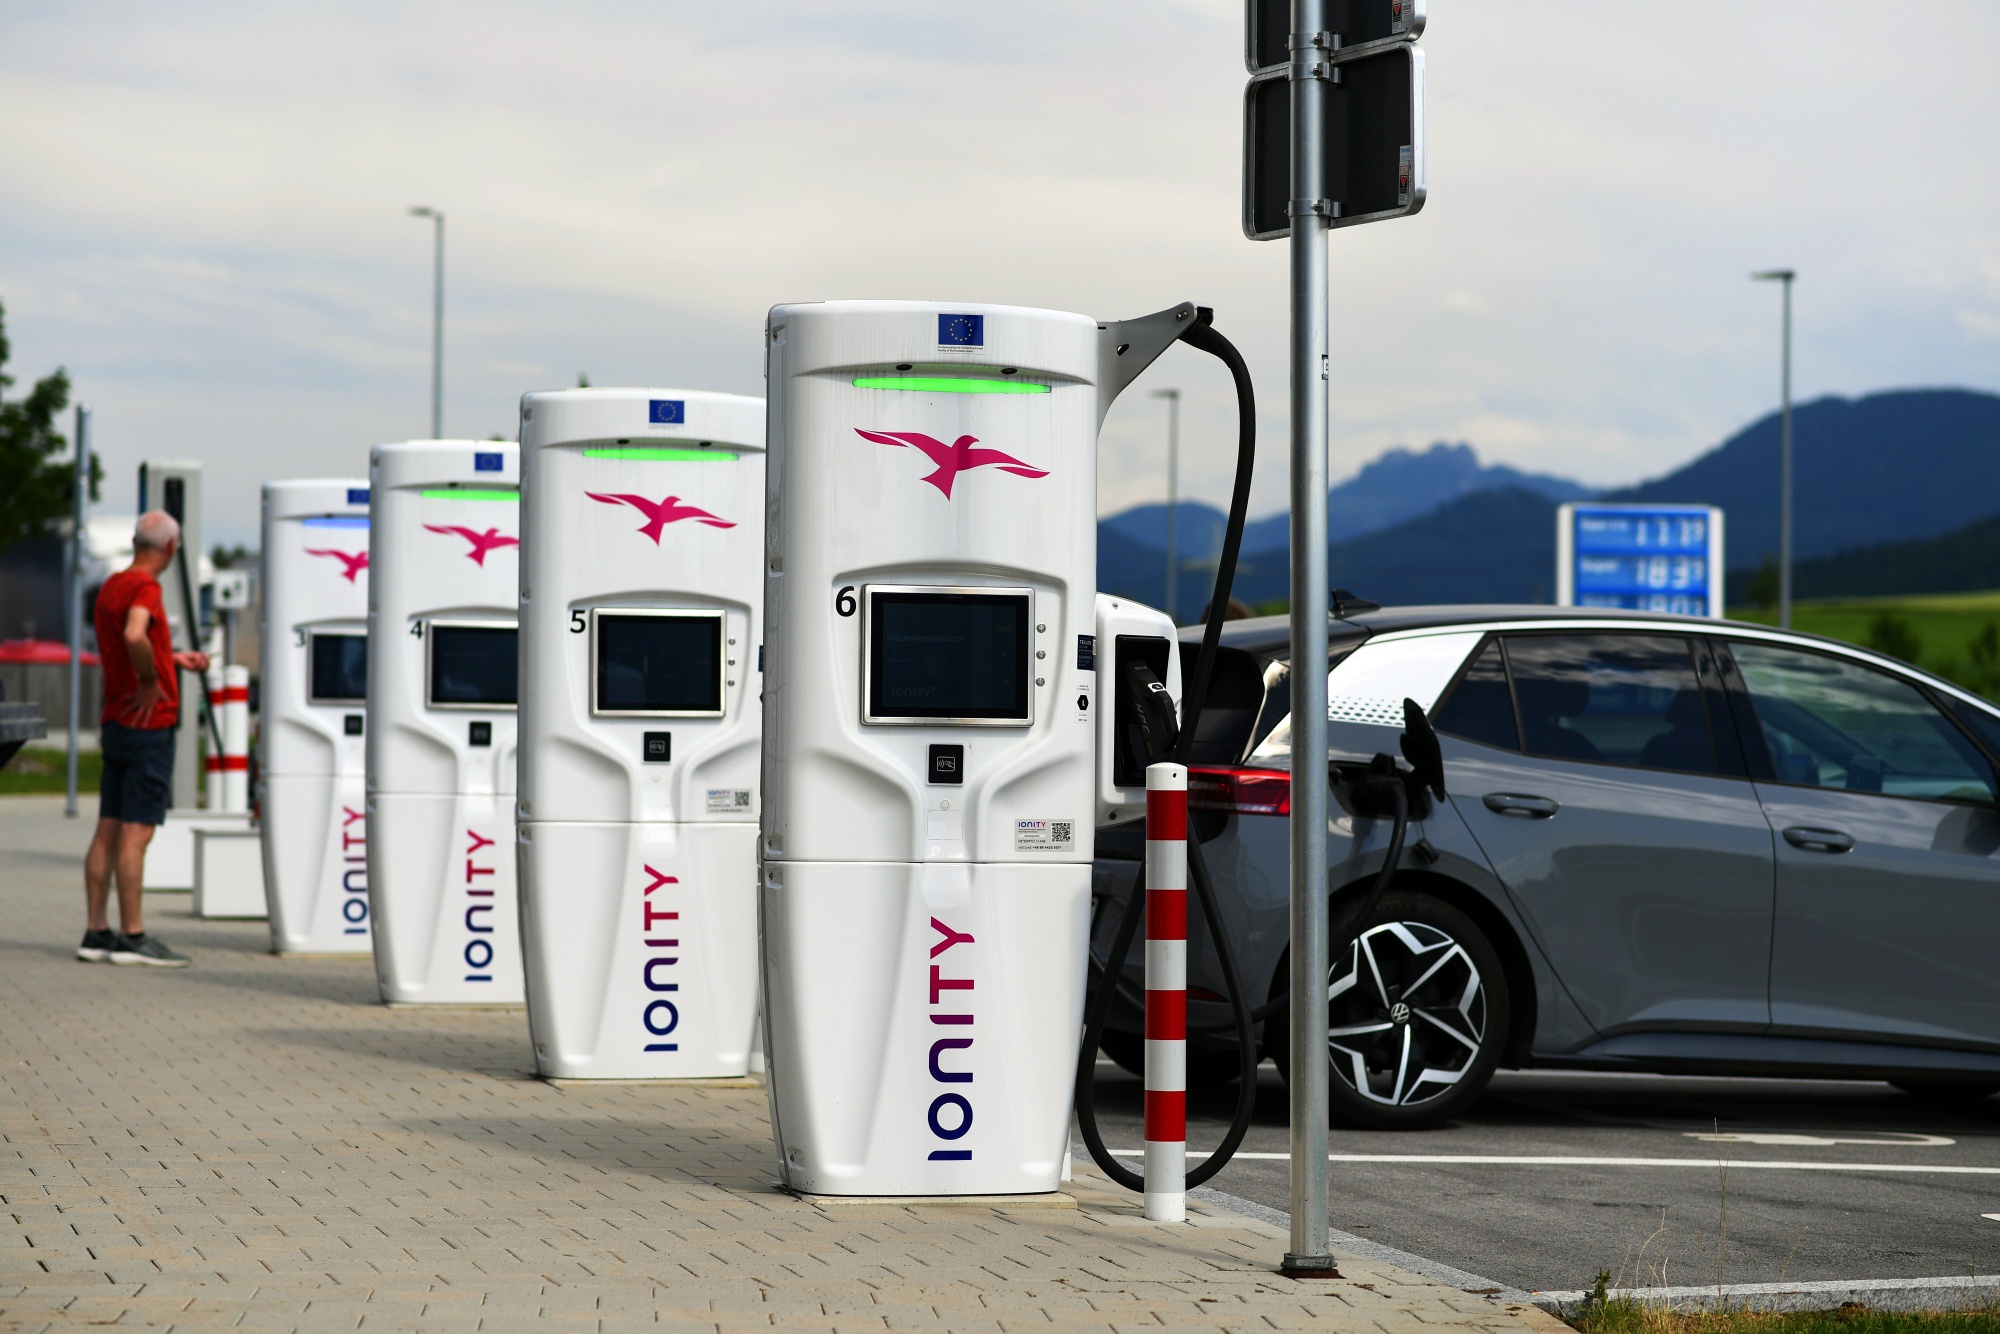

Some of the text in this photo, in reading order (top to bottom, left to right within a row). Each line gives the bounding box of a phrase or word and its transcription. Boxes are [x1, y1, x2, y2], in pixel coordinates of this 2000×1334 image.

[836, 586, 856, 617] 6
[410, 619, 425, 639] 4
[570, 610, 586, 633] 5
[295, 628, 305, 647] 3
[892, 687, 931, 697] IONITY
[343, 805, 367, 934] IONITY
[464, 829, 495, 981] IONITY
[643, 864, 679, 1052] IONITY
[928, 916, 975, 1161] IONITY
